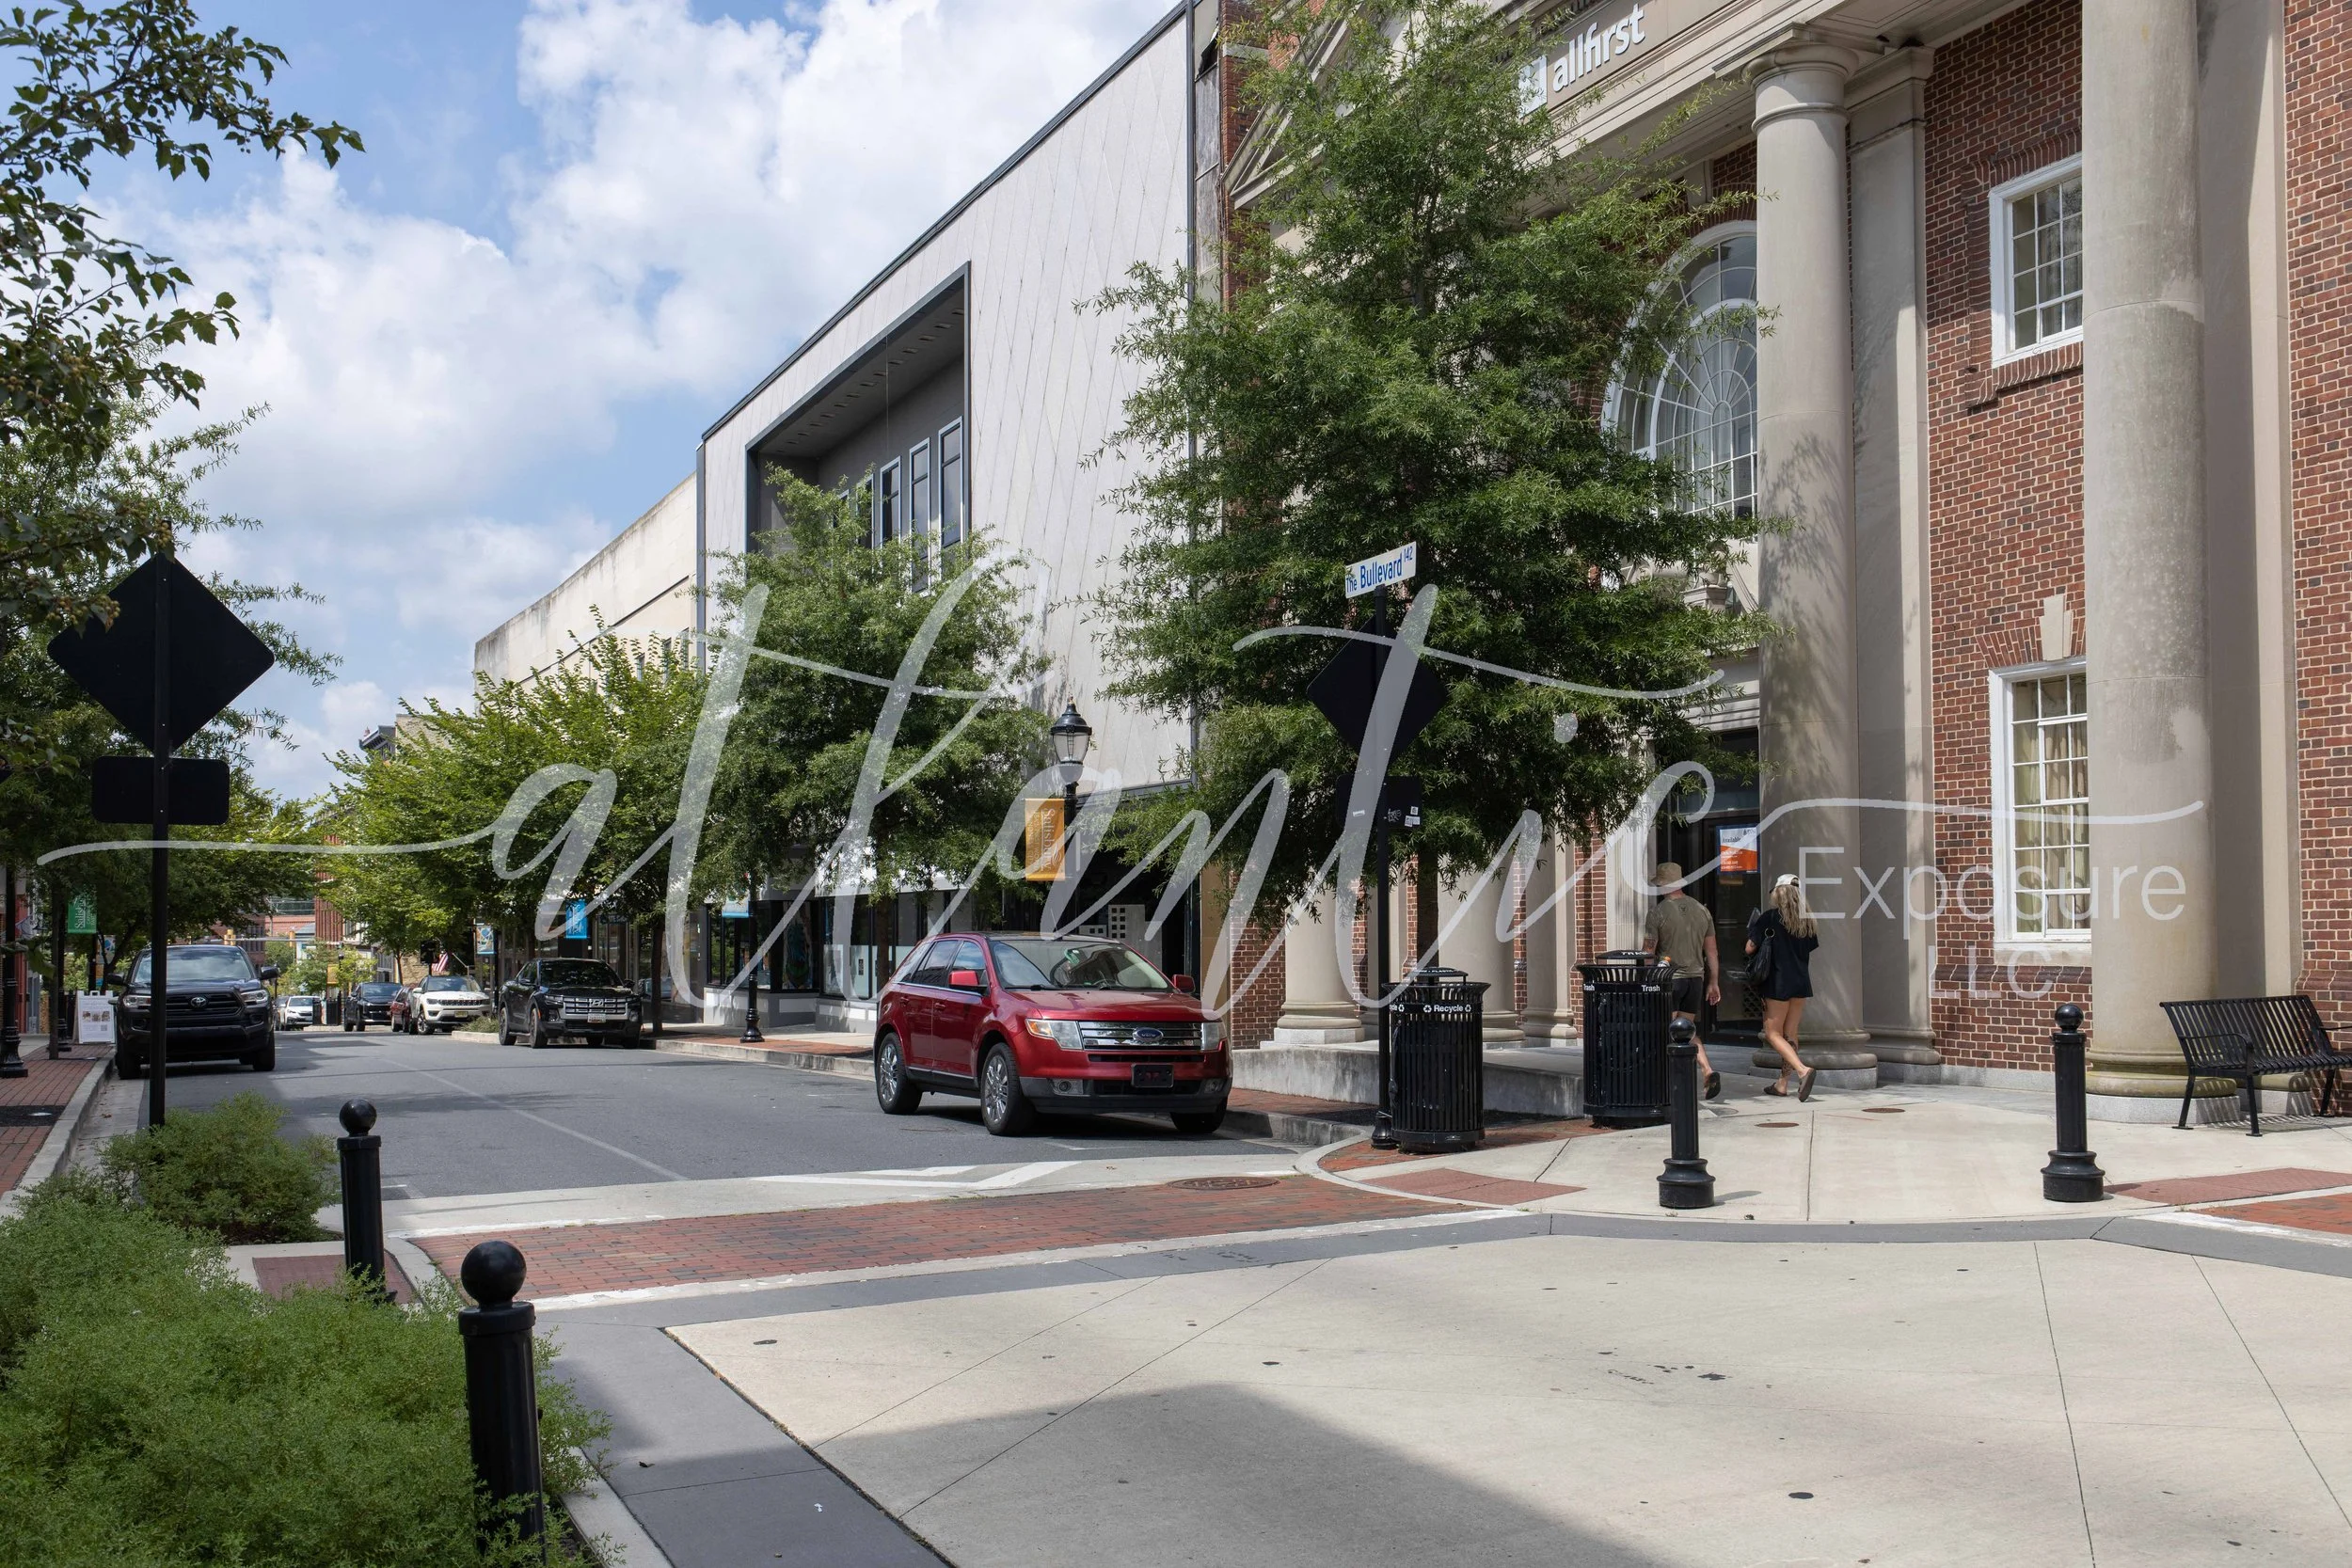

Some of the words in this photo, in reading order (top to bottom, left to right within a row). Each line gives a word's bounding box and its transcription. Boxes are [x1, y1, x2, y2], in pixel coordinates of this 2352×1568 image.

[1552, 3, 1646, 93] allfirst
[1345, 574, 1358, 593] The
[1359, 553, 1403, 589] Bullevard
[1041, 807, 1056, 871] Salisbury
[1641, 984, 1661, 992] Trash
[1433, 1005, 1464, 1013] Recycle
